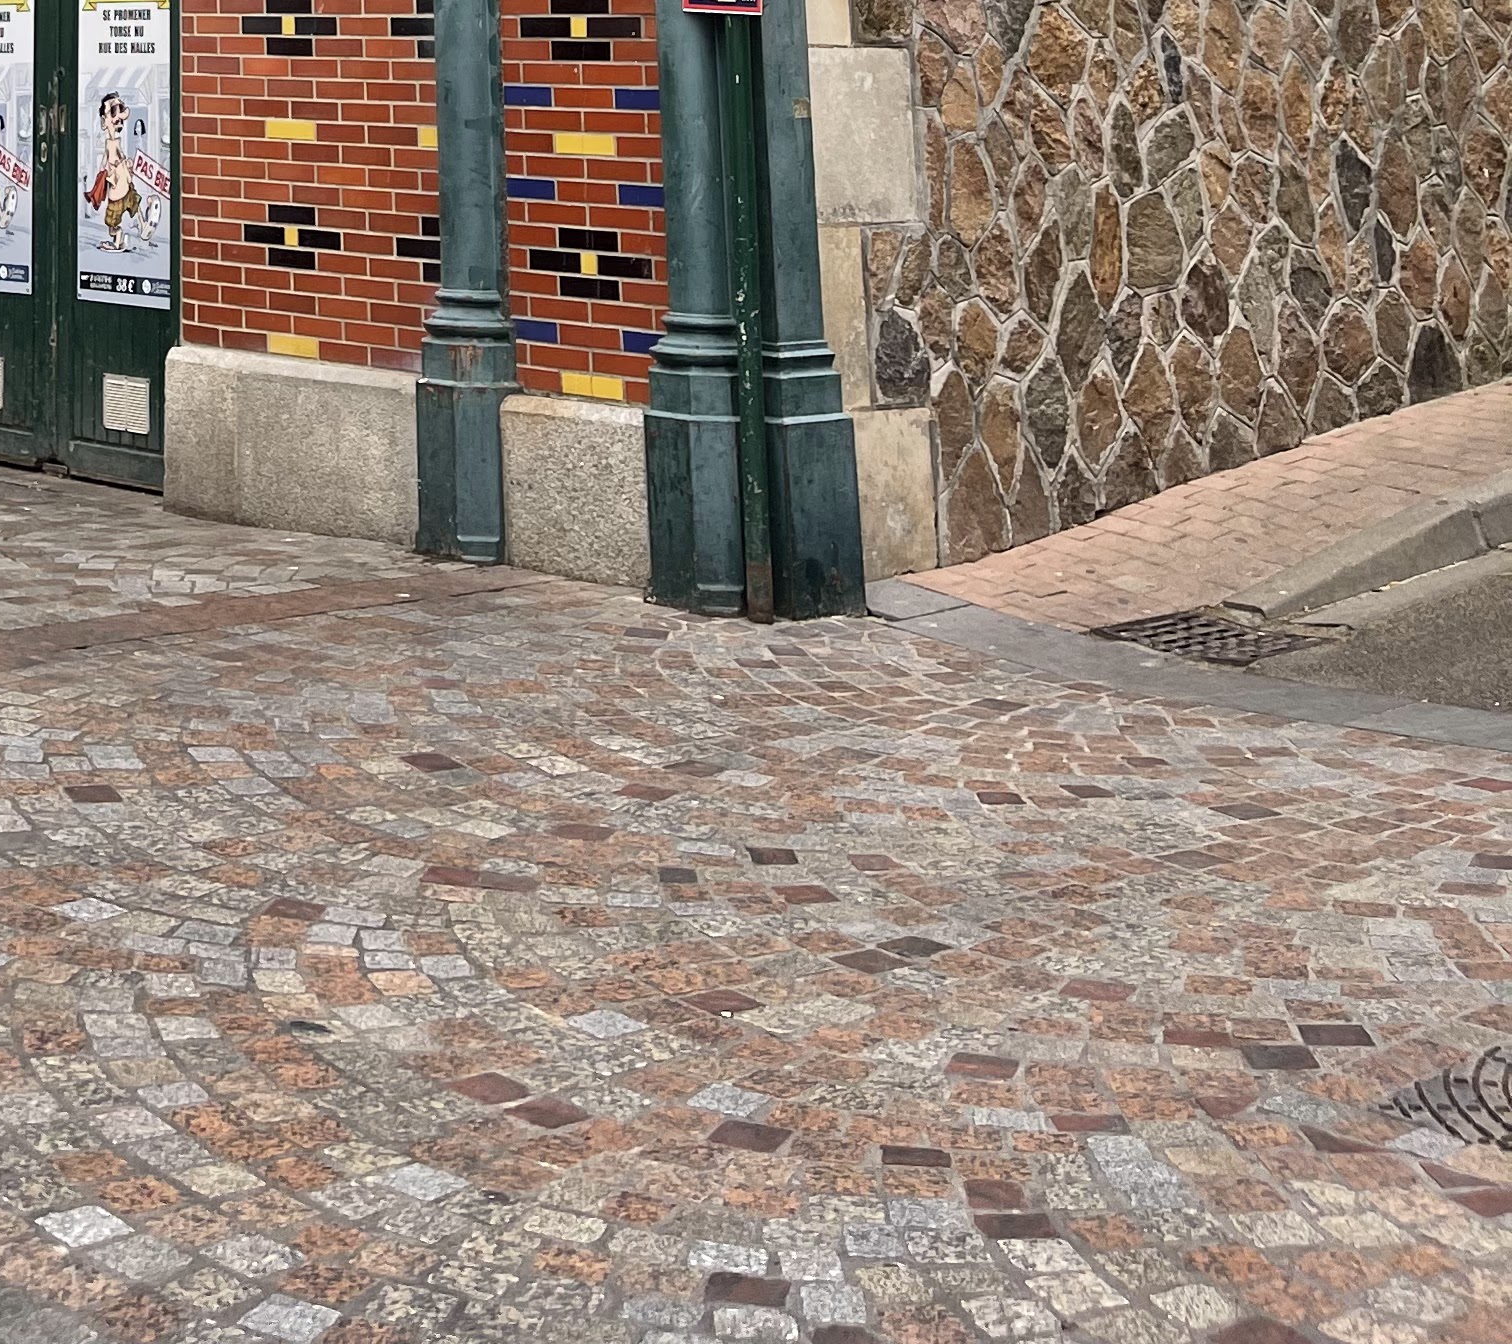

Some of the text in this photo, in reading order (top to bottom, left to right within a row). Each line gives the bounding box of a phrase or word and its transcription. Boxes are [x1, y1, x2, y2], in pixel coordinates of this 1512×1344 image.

[103, 9, 151, 21] SE PROMENER
[110, 26, 144, 37] TORSE NU
[99, 42, 111, 54] RUE
[115, 42, 127, 54] DES
[136, 155, 154, 180] PAS
